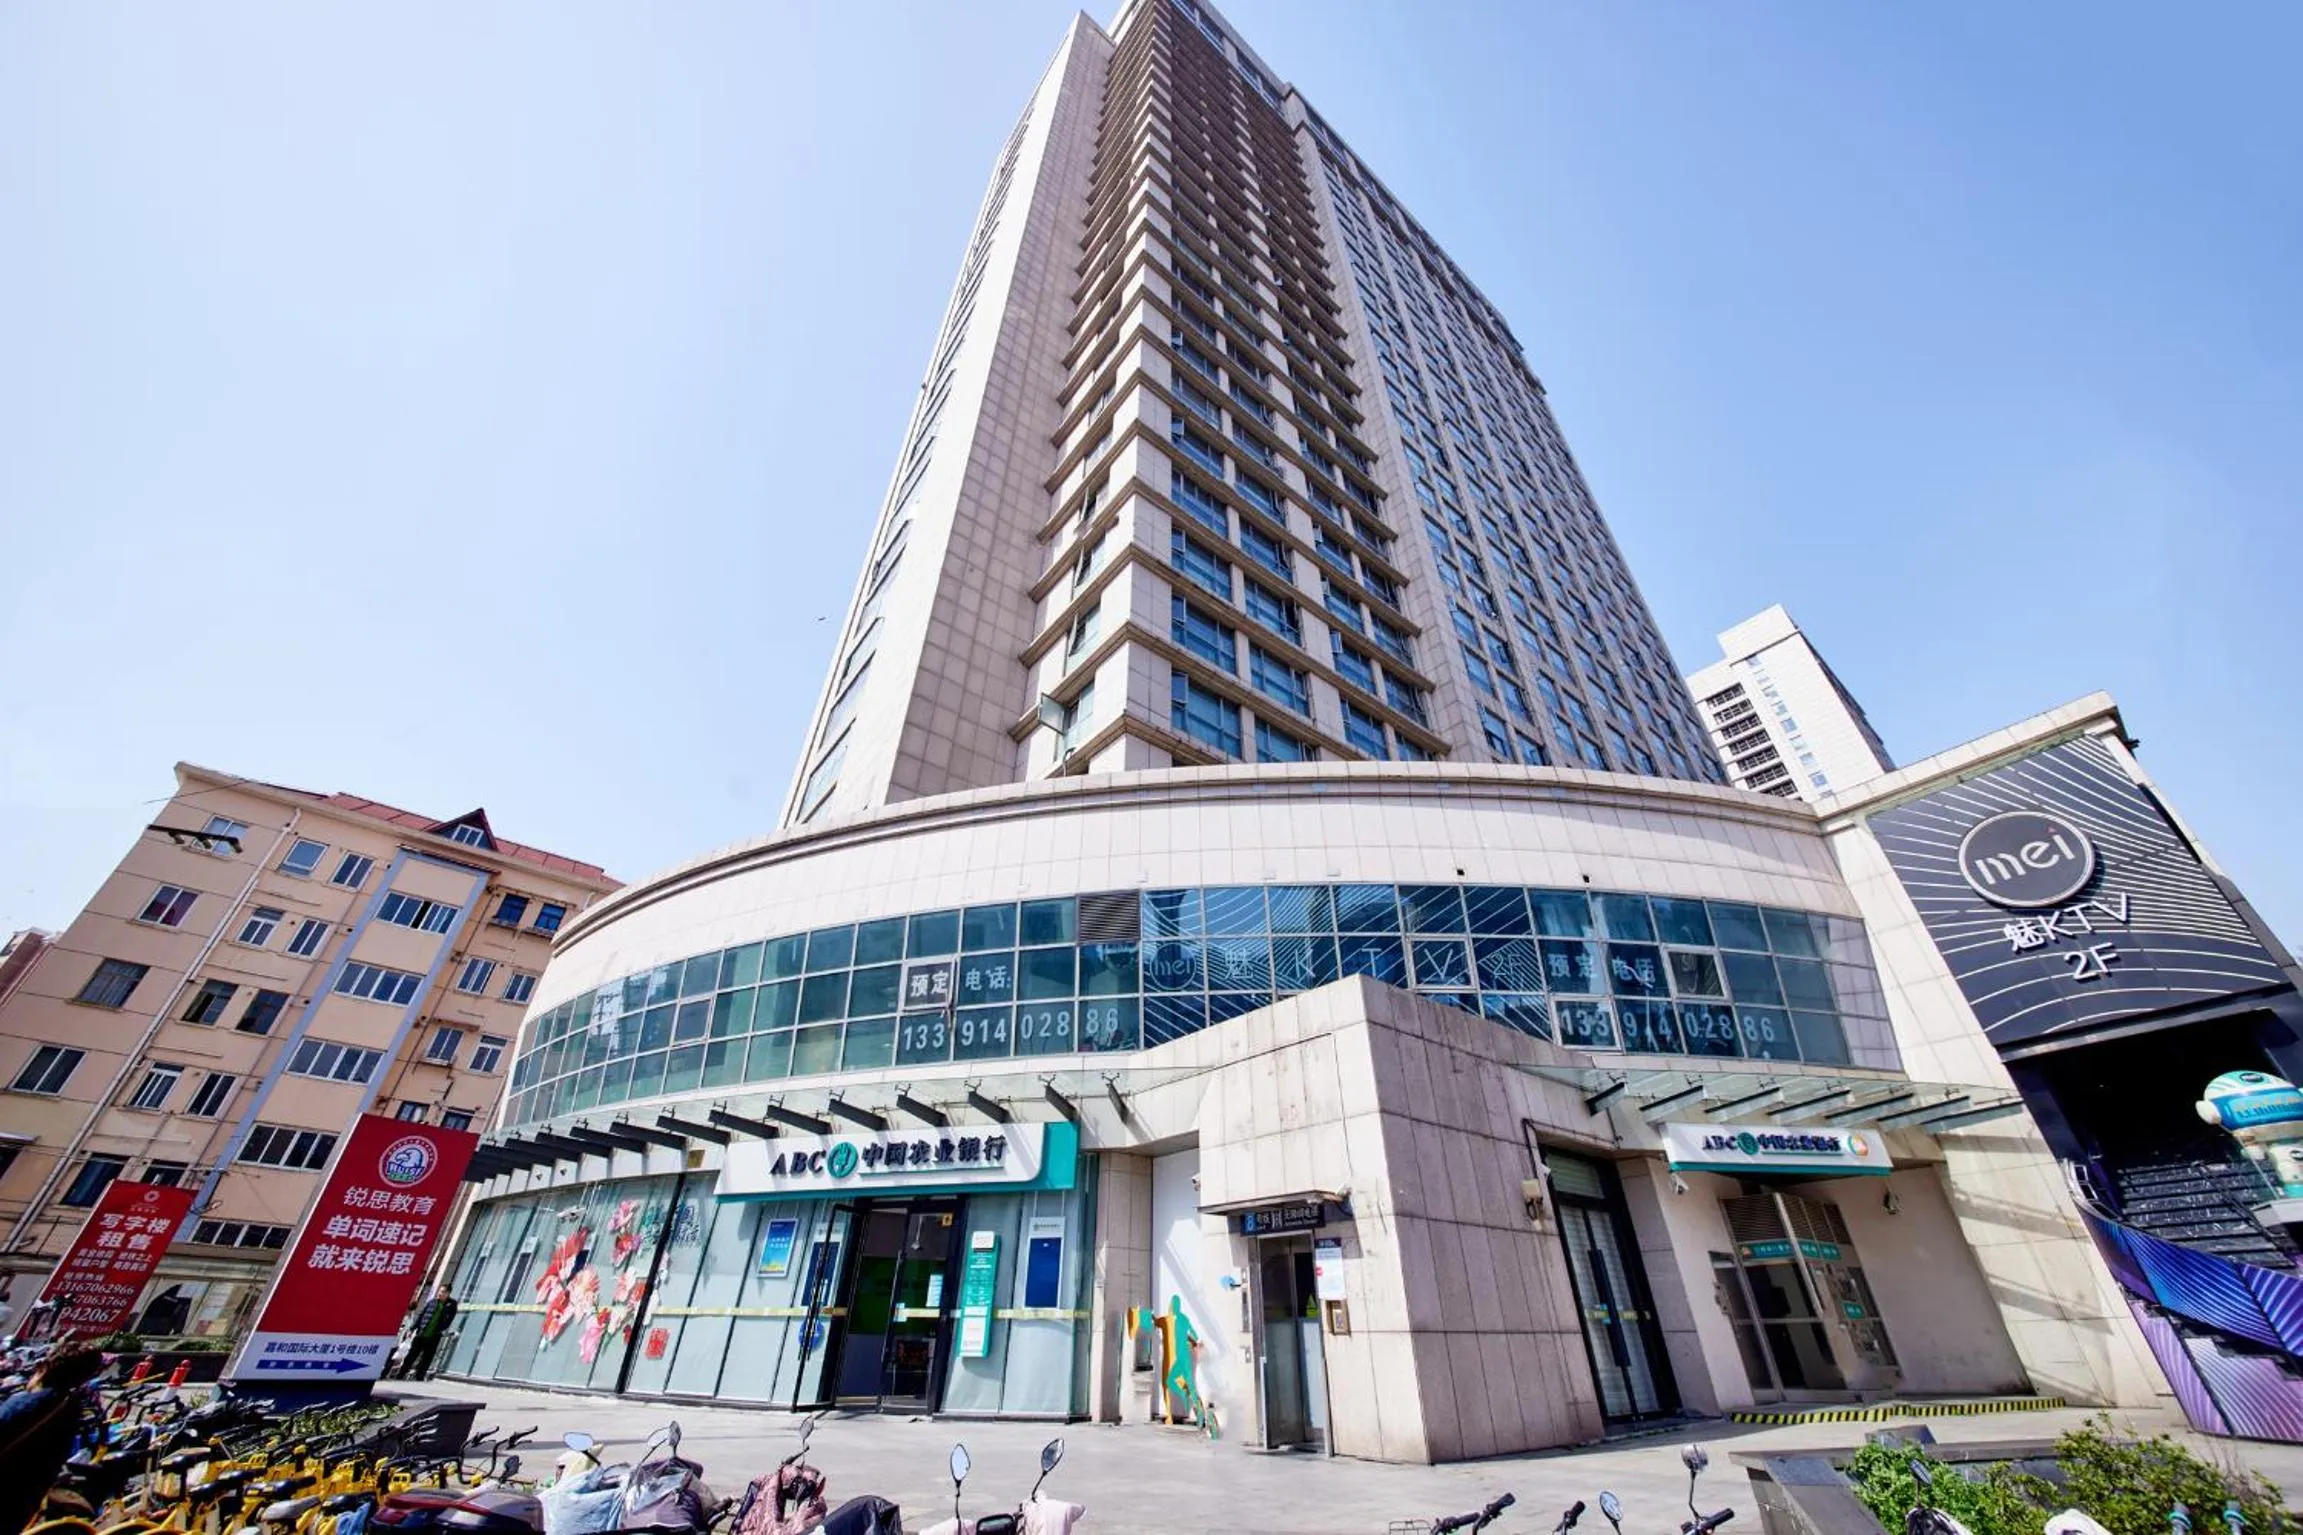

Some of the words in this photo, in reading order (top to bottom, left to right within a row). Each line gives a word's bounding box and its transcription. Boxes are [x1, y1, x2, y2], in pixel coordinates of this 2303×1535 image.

[1974, 826, 2076, 885] mei
[2002, 891, 2128, 951] 魅KTV
[2063, 942, 2118, 980] 2F
[909, 969, 950, 998] 预定
[769, 1150, 827, 1176] ABC
[861, 1135, 1007, 1167] 中国农业银行
[343, 1185, 437, 1216] 锐思教育
[99, 1213, 172, 1234] 写字楼
[322, 1214, 429, 1247] 单词速记
[96, 1231, 154, 1251] 租售
[307, 1244, 417, 1275] 就来锐思
